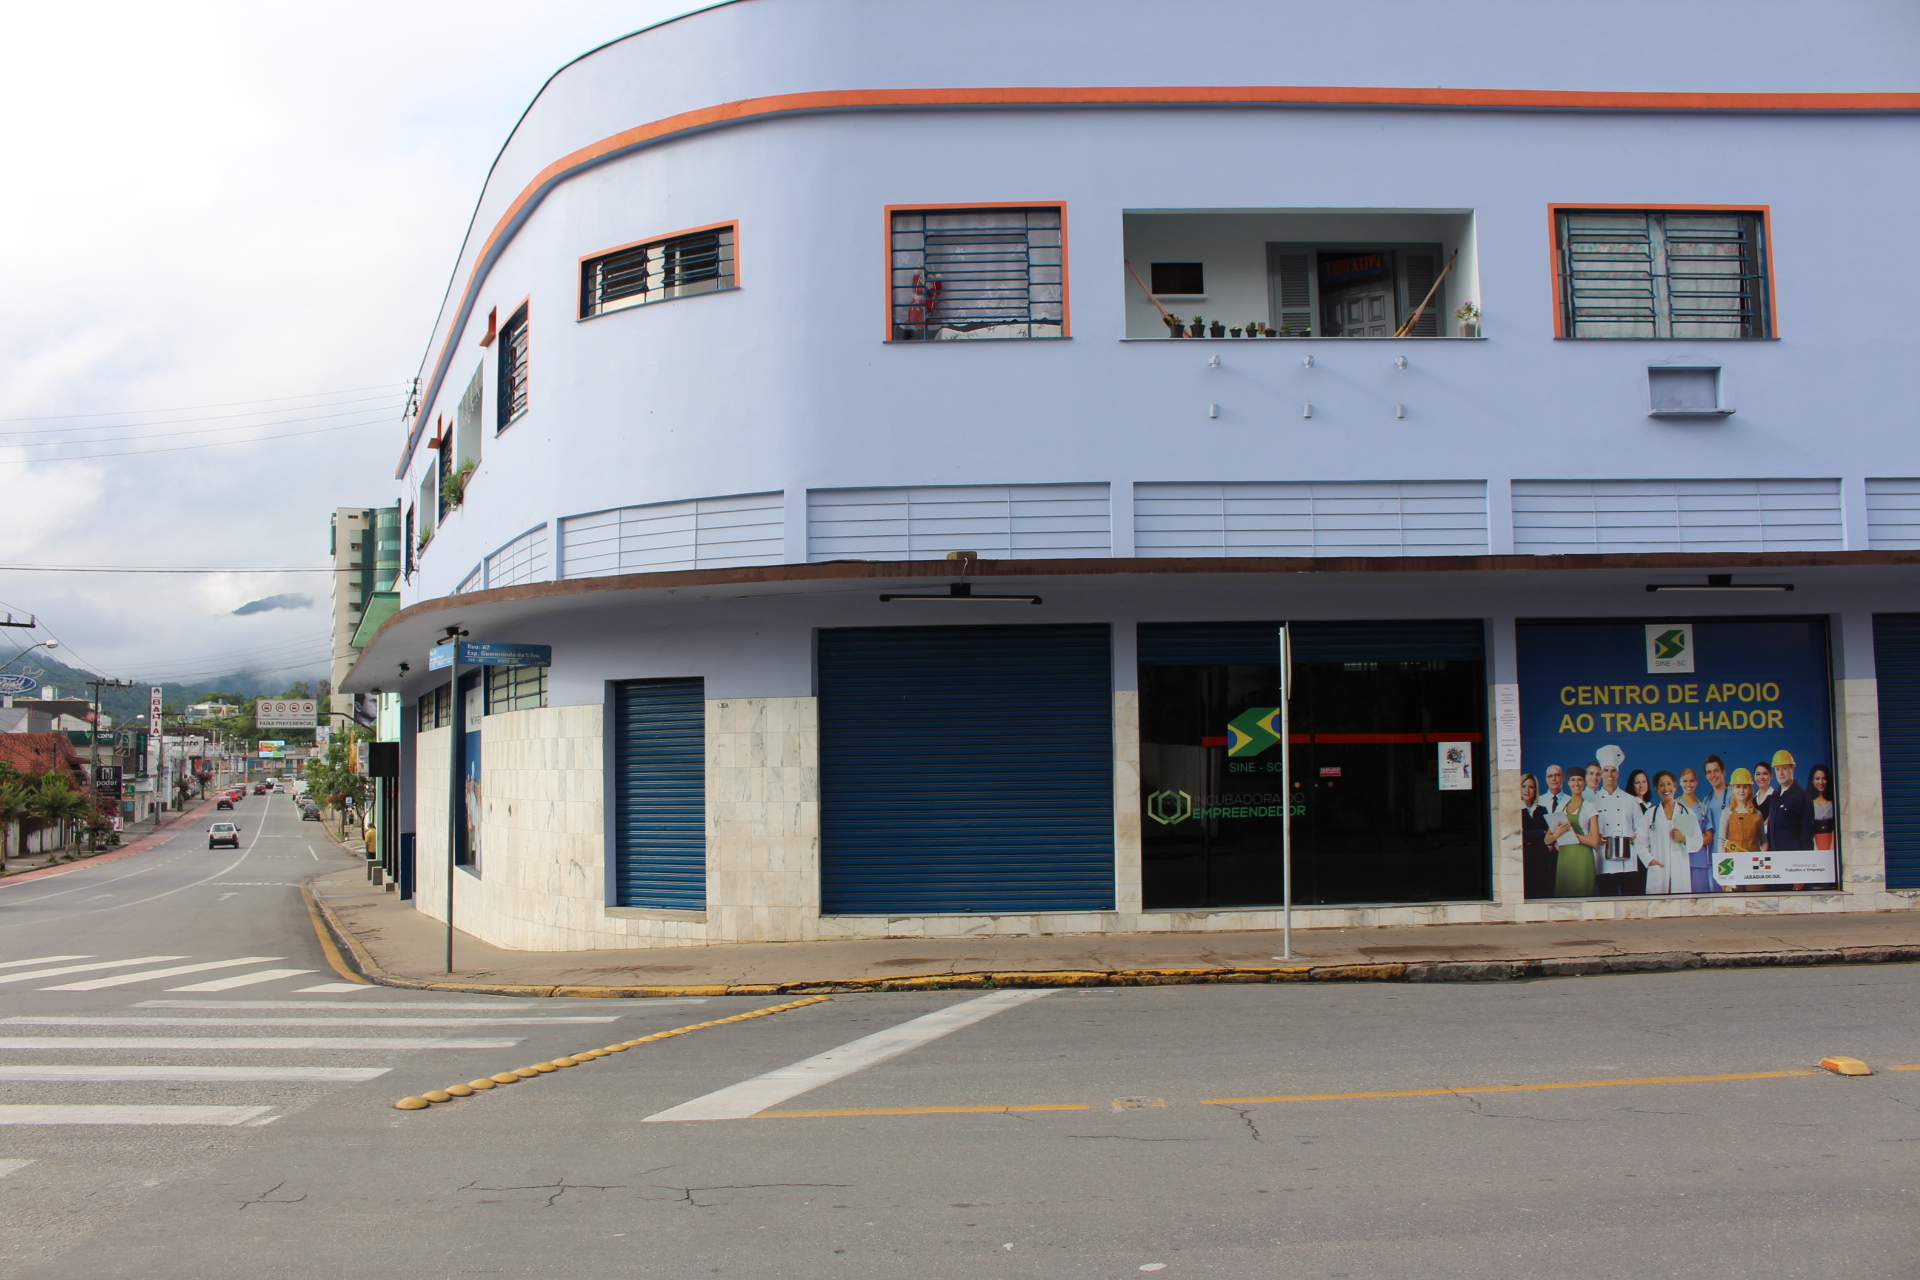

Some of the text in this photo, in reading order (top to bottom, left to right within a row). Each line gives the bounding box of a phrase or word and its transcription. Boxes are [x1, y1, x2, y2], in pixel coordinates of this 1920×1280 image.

[1560, 682, 1780, 705] CENTRO DE APOIO
[152, 698, 161, 734] BAHIA
[1558, 709, 1784, 733] AO TRABALHADOR
[1229, 762, 1256, 772] SINE
[1266, 762, 1283, 772] SC
[1194, 793, 1281, 806] INCUBADORA
[1192, 805, 1306, 819] EMPREENDEDOR
